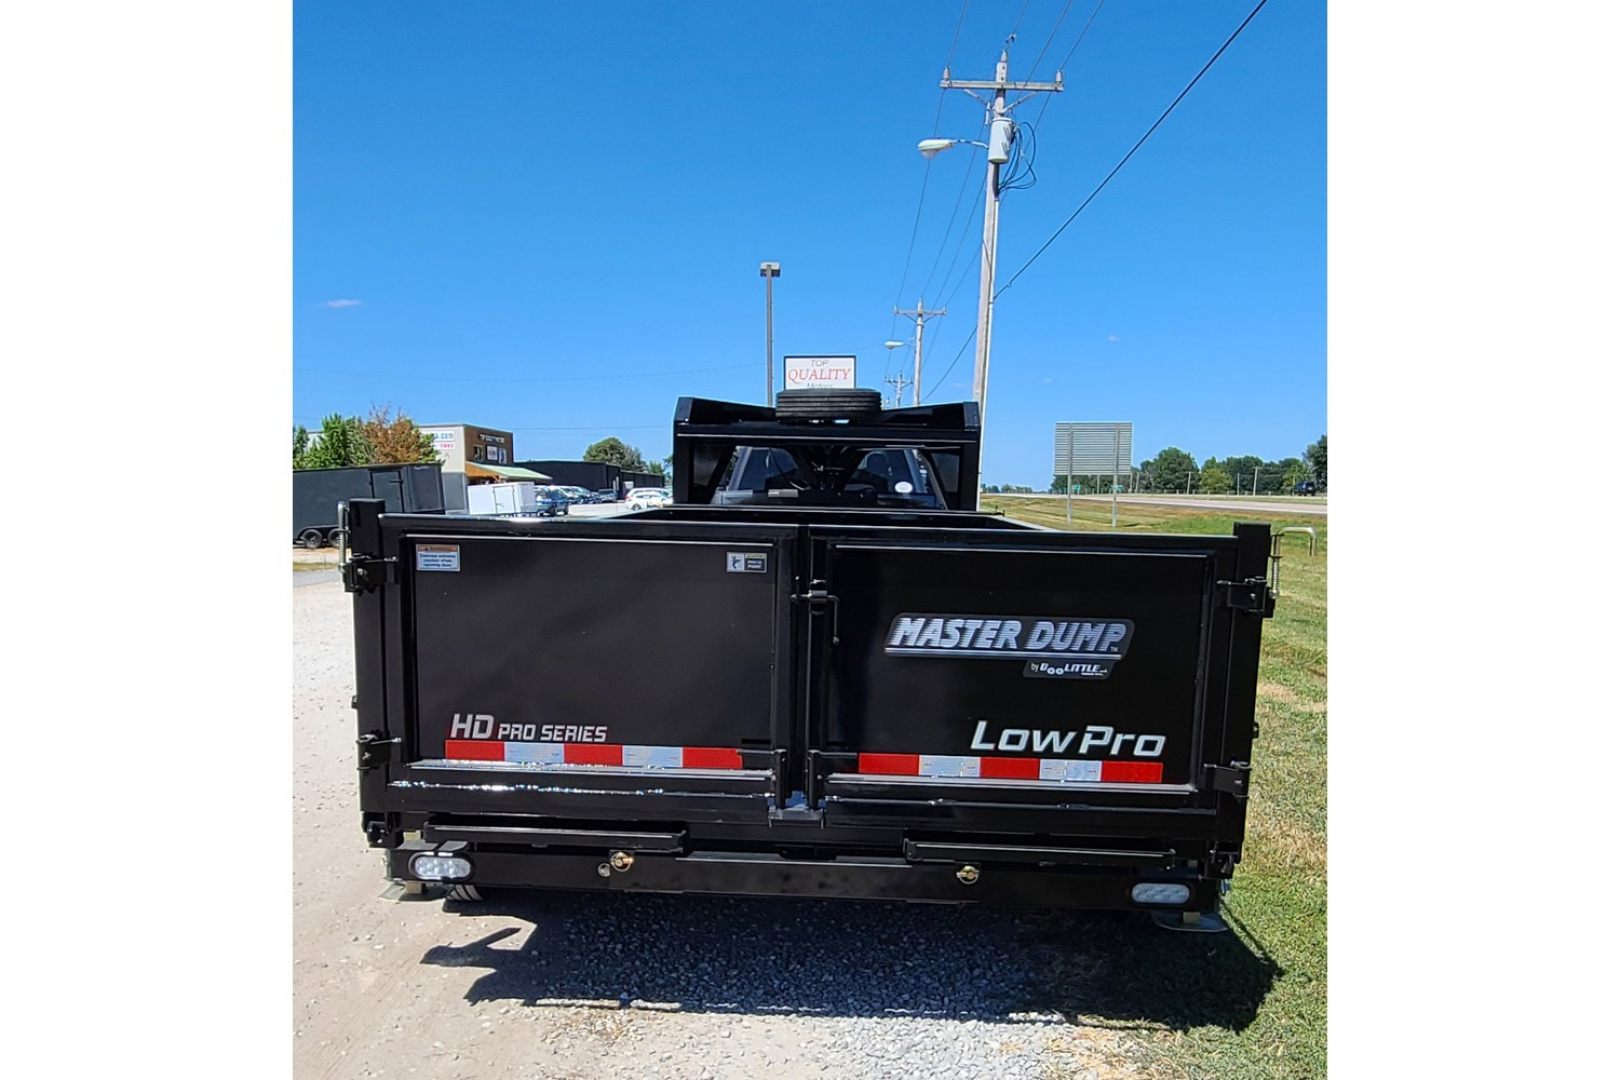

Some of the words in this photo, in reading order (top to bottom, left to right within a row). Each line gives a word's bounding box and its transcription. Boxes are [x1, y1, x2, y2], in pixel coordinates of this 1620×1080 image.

[811, 359, 829, 367] TOP
[788, 368, 851, 384] QUALITY
[889, 617, 1022, 649] MASTER
[1024, 620, 1126, 651] DUMP
[1030, 662, 1039, 672] by
[450, 713, 494, 740] HD
[497, 723, 536, 741] PRO
[540, 725, 608, 743] SERIES
